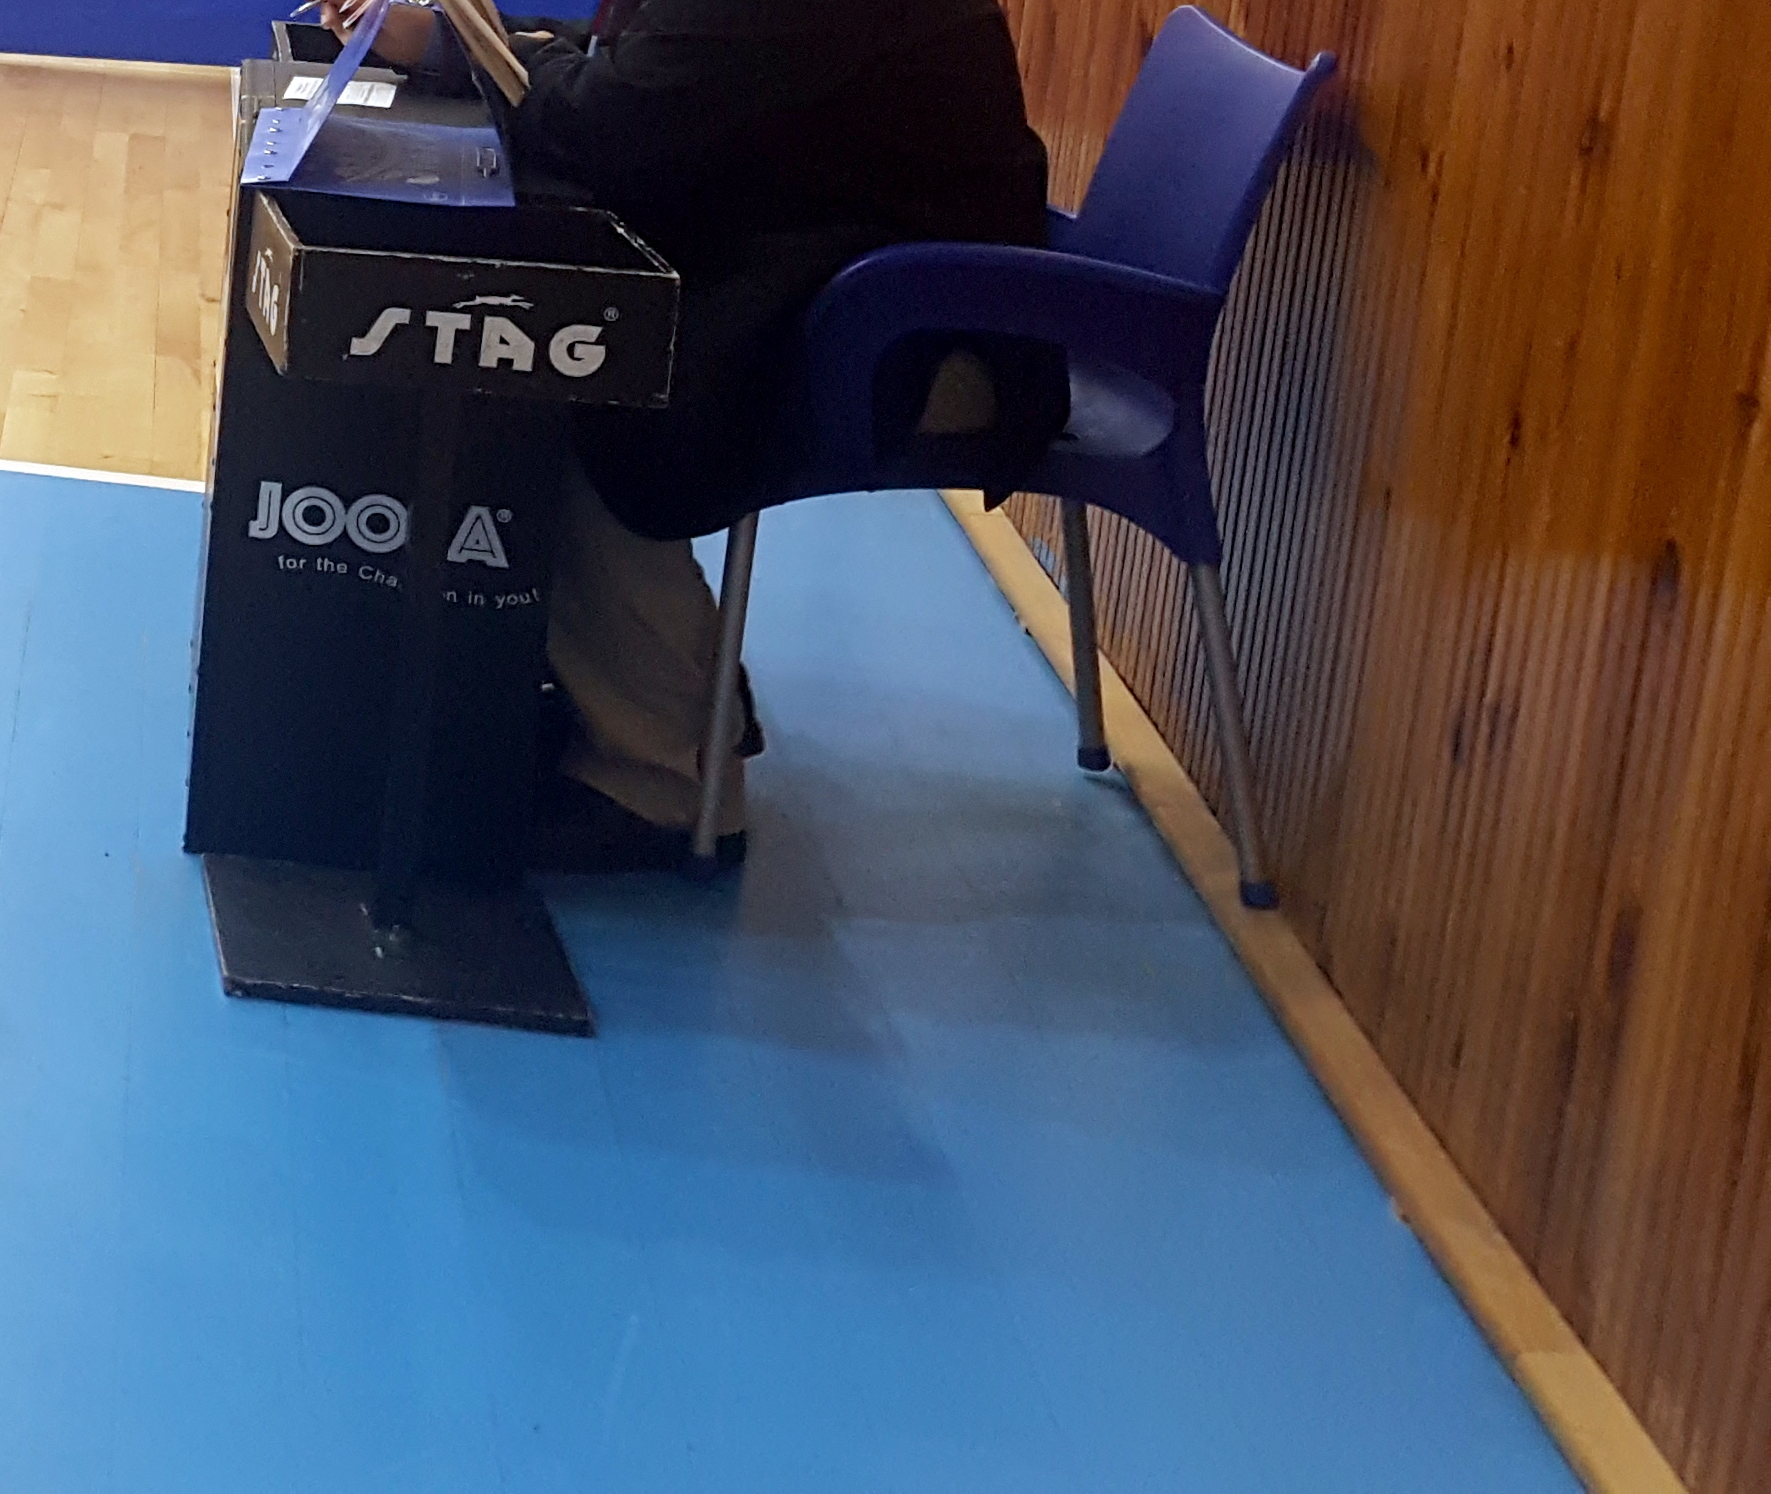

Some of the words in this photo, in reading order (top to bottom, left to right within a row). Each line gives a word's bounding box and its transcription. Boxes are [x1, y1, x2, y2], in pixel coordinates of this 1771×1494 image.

[349, 307, 606, 377] STAG
[248, 480, 510, 569] JOOA
[277, 555, 307, 570] for
[316, 557, 348, 574] the
[468, 590, 485, 606] in
